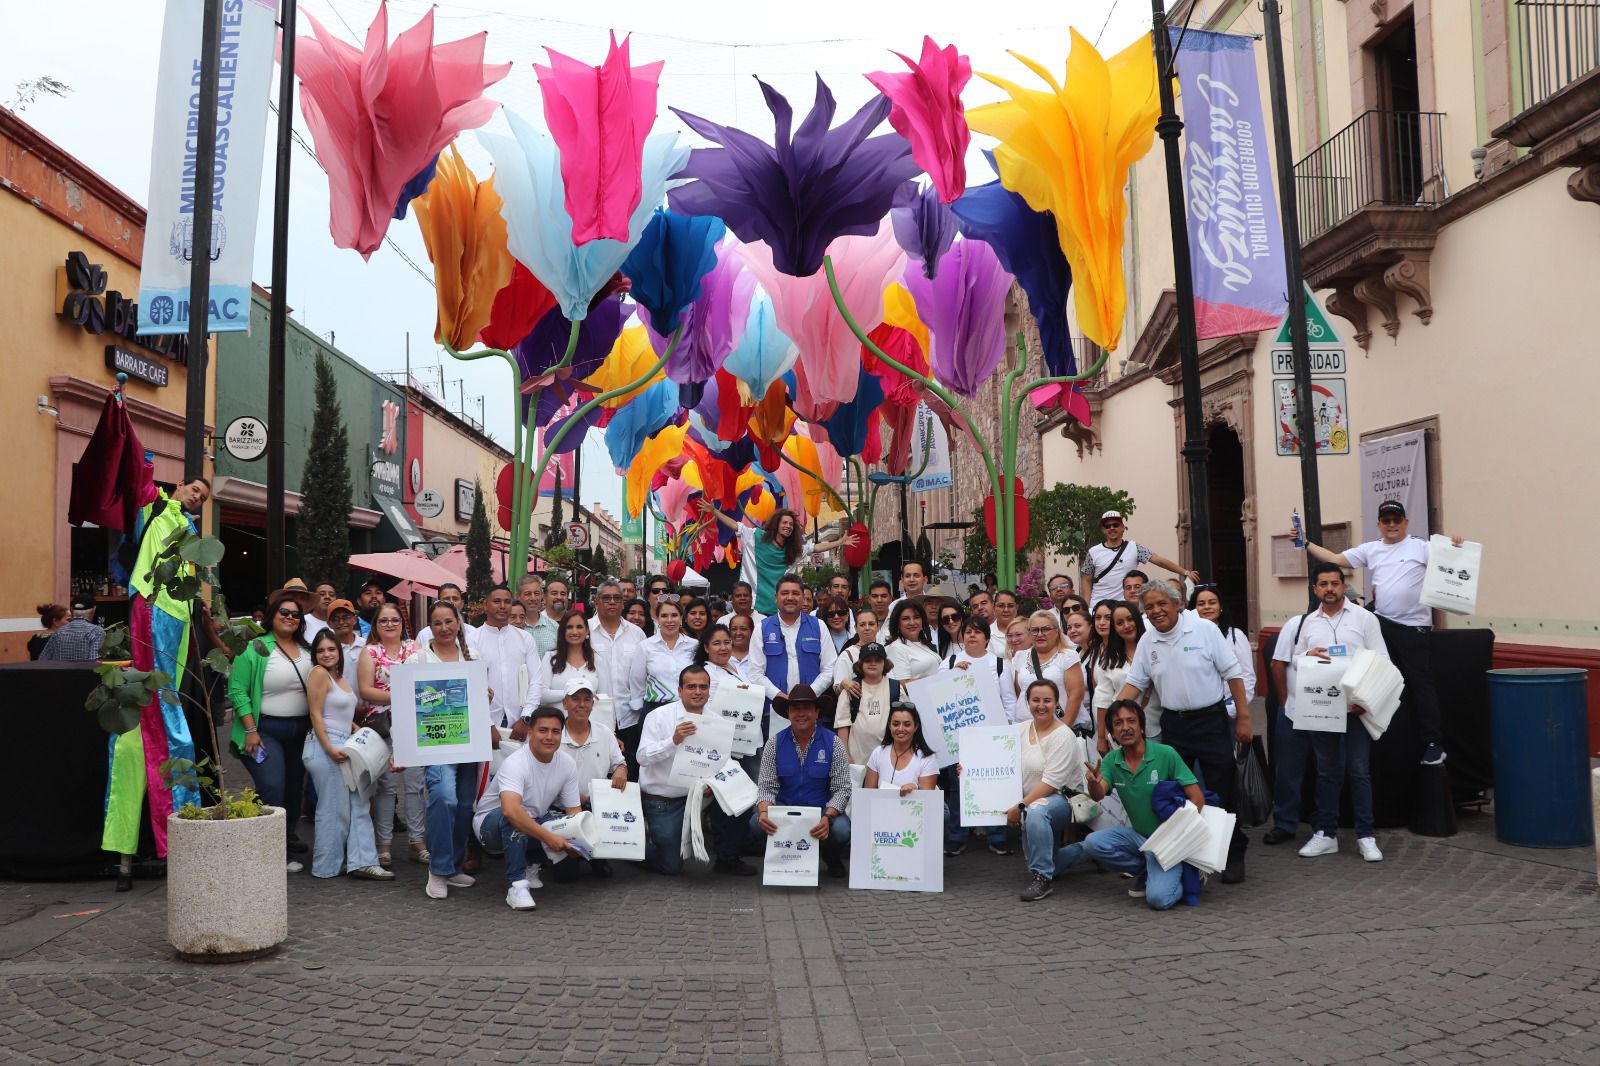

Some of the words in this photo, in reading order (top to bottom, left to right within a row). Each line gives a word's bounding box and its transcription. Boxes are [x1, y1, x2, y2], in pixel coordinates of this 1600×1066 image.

[1235, 120, 1260, 191] CORREDOR
[1244, 193, 1270, 260] CULTURAL
[115, 350, 138, 373] BARRA
[138, 361, 148, 377] DE
[148, 366, 167, 385] CAFÉ
[1277, 353, 1341, 370] PRRIDAD
[228, 437, 264, 445] BARIZZIMO
[1371, 464, 1411, 480] PROGRAMA
[925, 476, 948, 487] IMAC
[1374, 478, 1410, 492] CULTURAL
[958, 695, 980, 706] VIDA
[943, 714, 986, 733] PLÁSTICO
